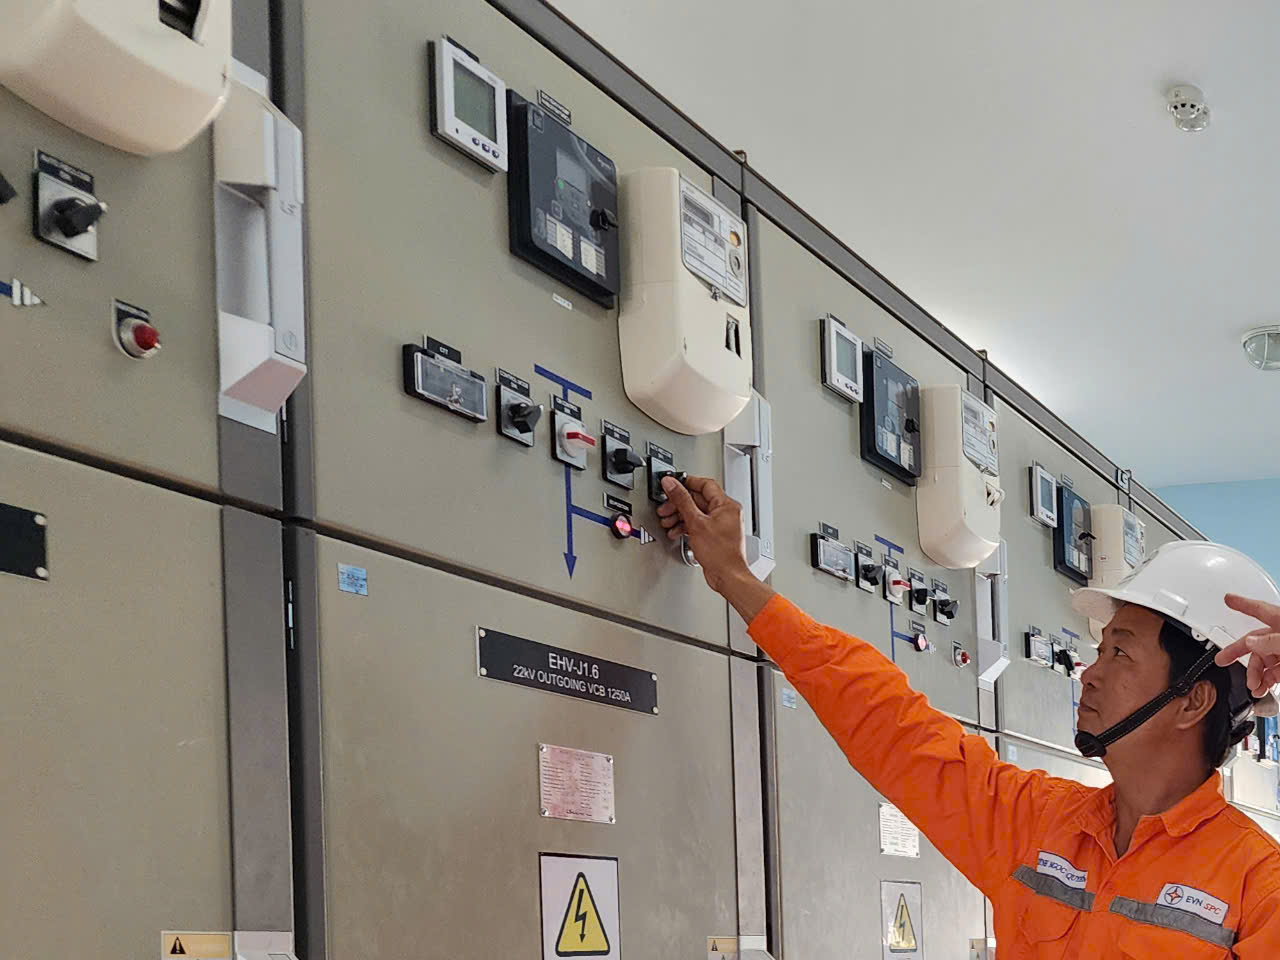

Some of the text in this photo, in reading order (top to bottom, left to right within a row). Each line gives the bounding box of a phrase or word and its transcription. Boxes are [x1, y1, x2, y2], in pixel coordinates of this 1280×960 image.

[548, 652, 600, 679] EHV-J1.6
[512, 664, 632, 702] 22kV OUTGOING VCB 1250A
[1185, 895, 1222, 915] EVN SPC
